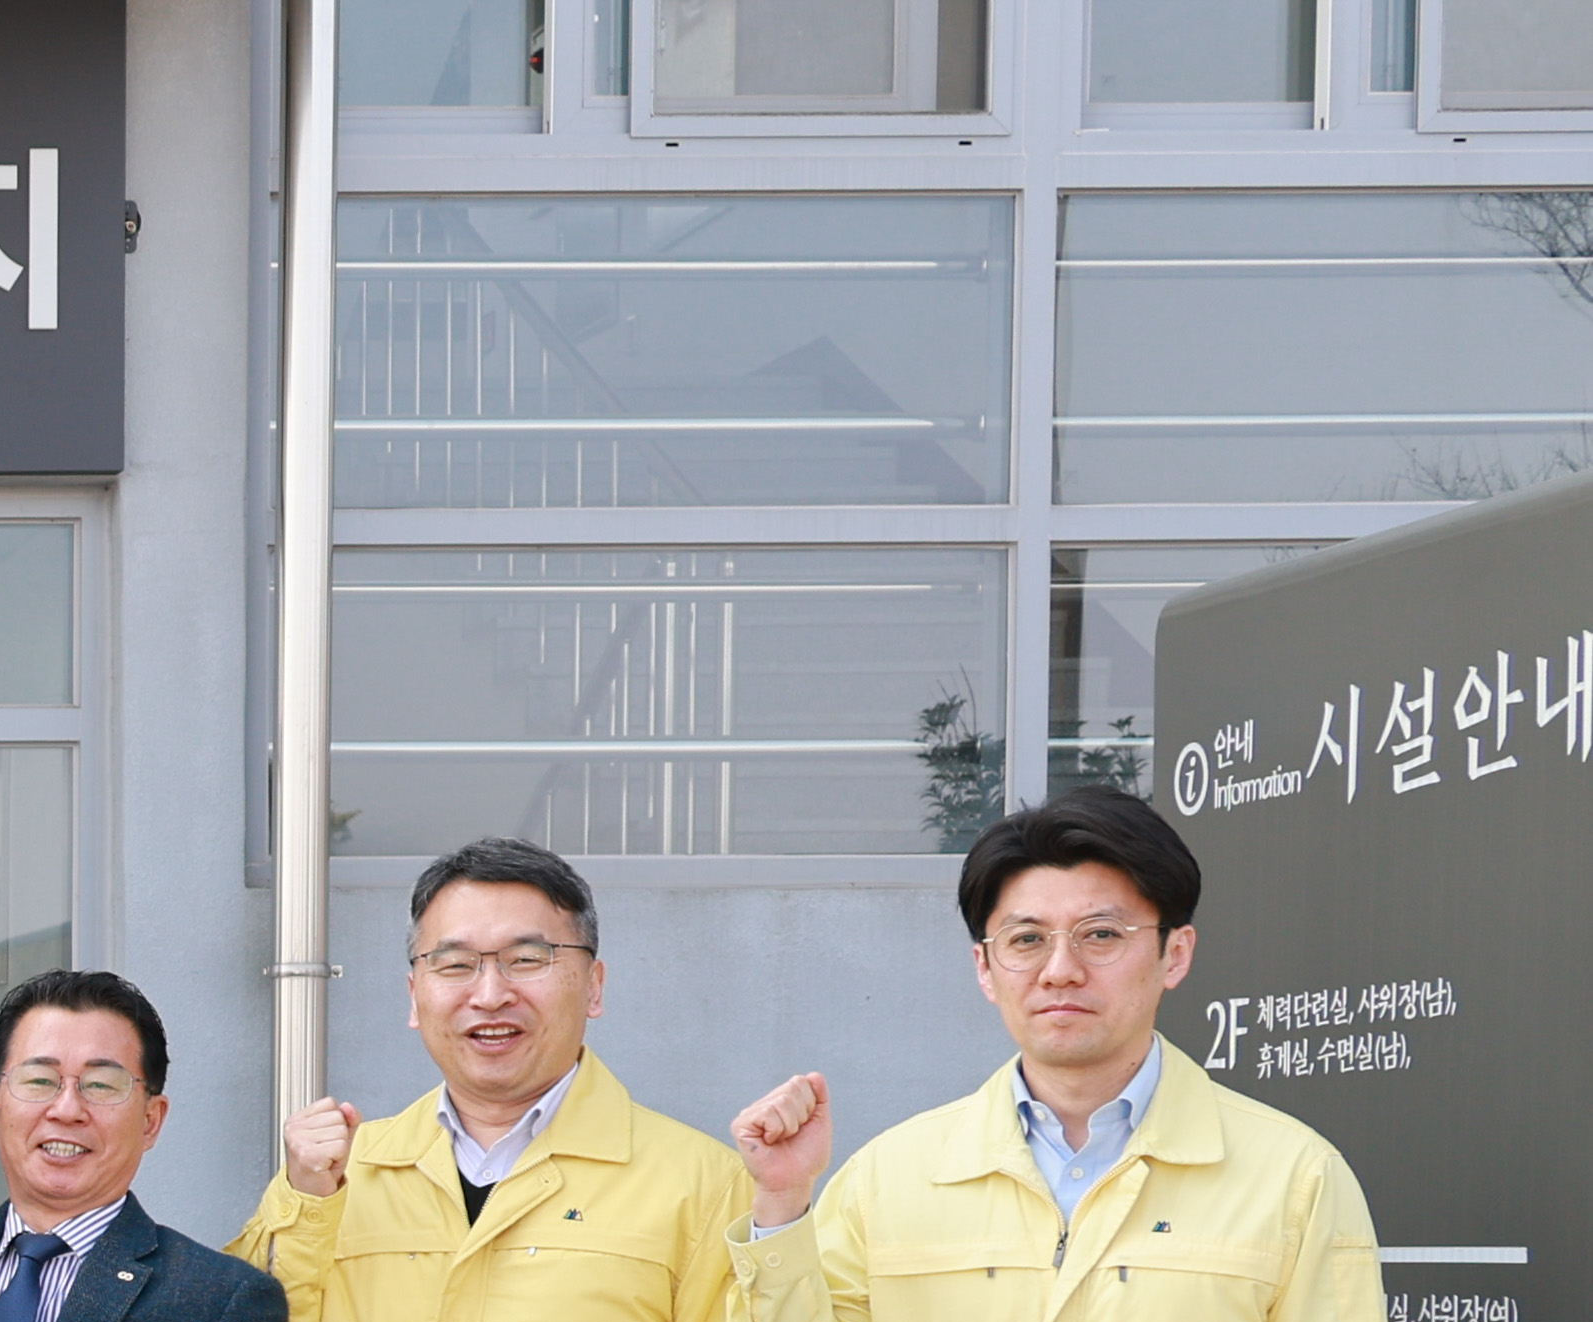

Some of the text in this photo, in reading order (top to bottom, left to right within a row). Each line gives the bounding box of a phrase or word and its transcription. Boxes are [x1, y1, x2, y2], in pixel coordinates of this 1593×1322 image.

[1214, 718, 1254, 769] 안내
[1214, 764, 1302, 812] Information
[1204, 997, 1251, 1071] 2F
[1257, 986, 1354, 1032] 체력단련실,
[1256, 1030, 1412, 1080] 휴게실, 수면실(남),
